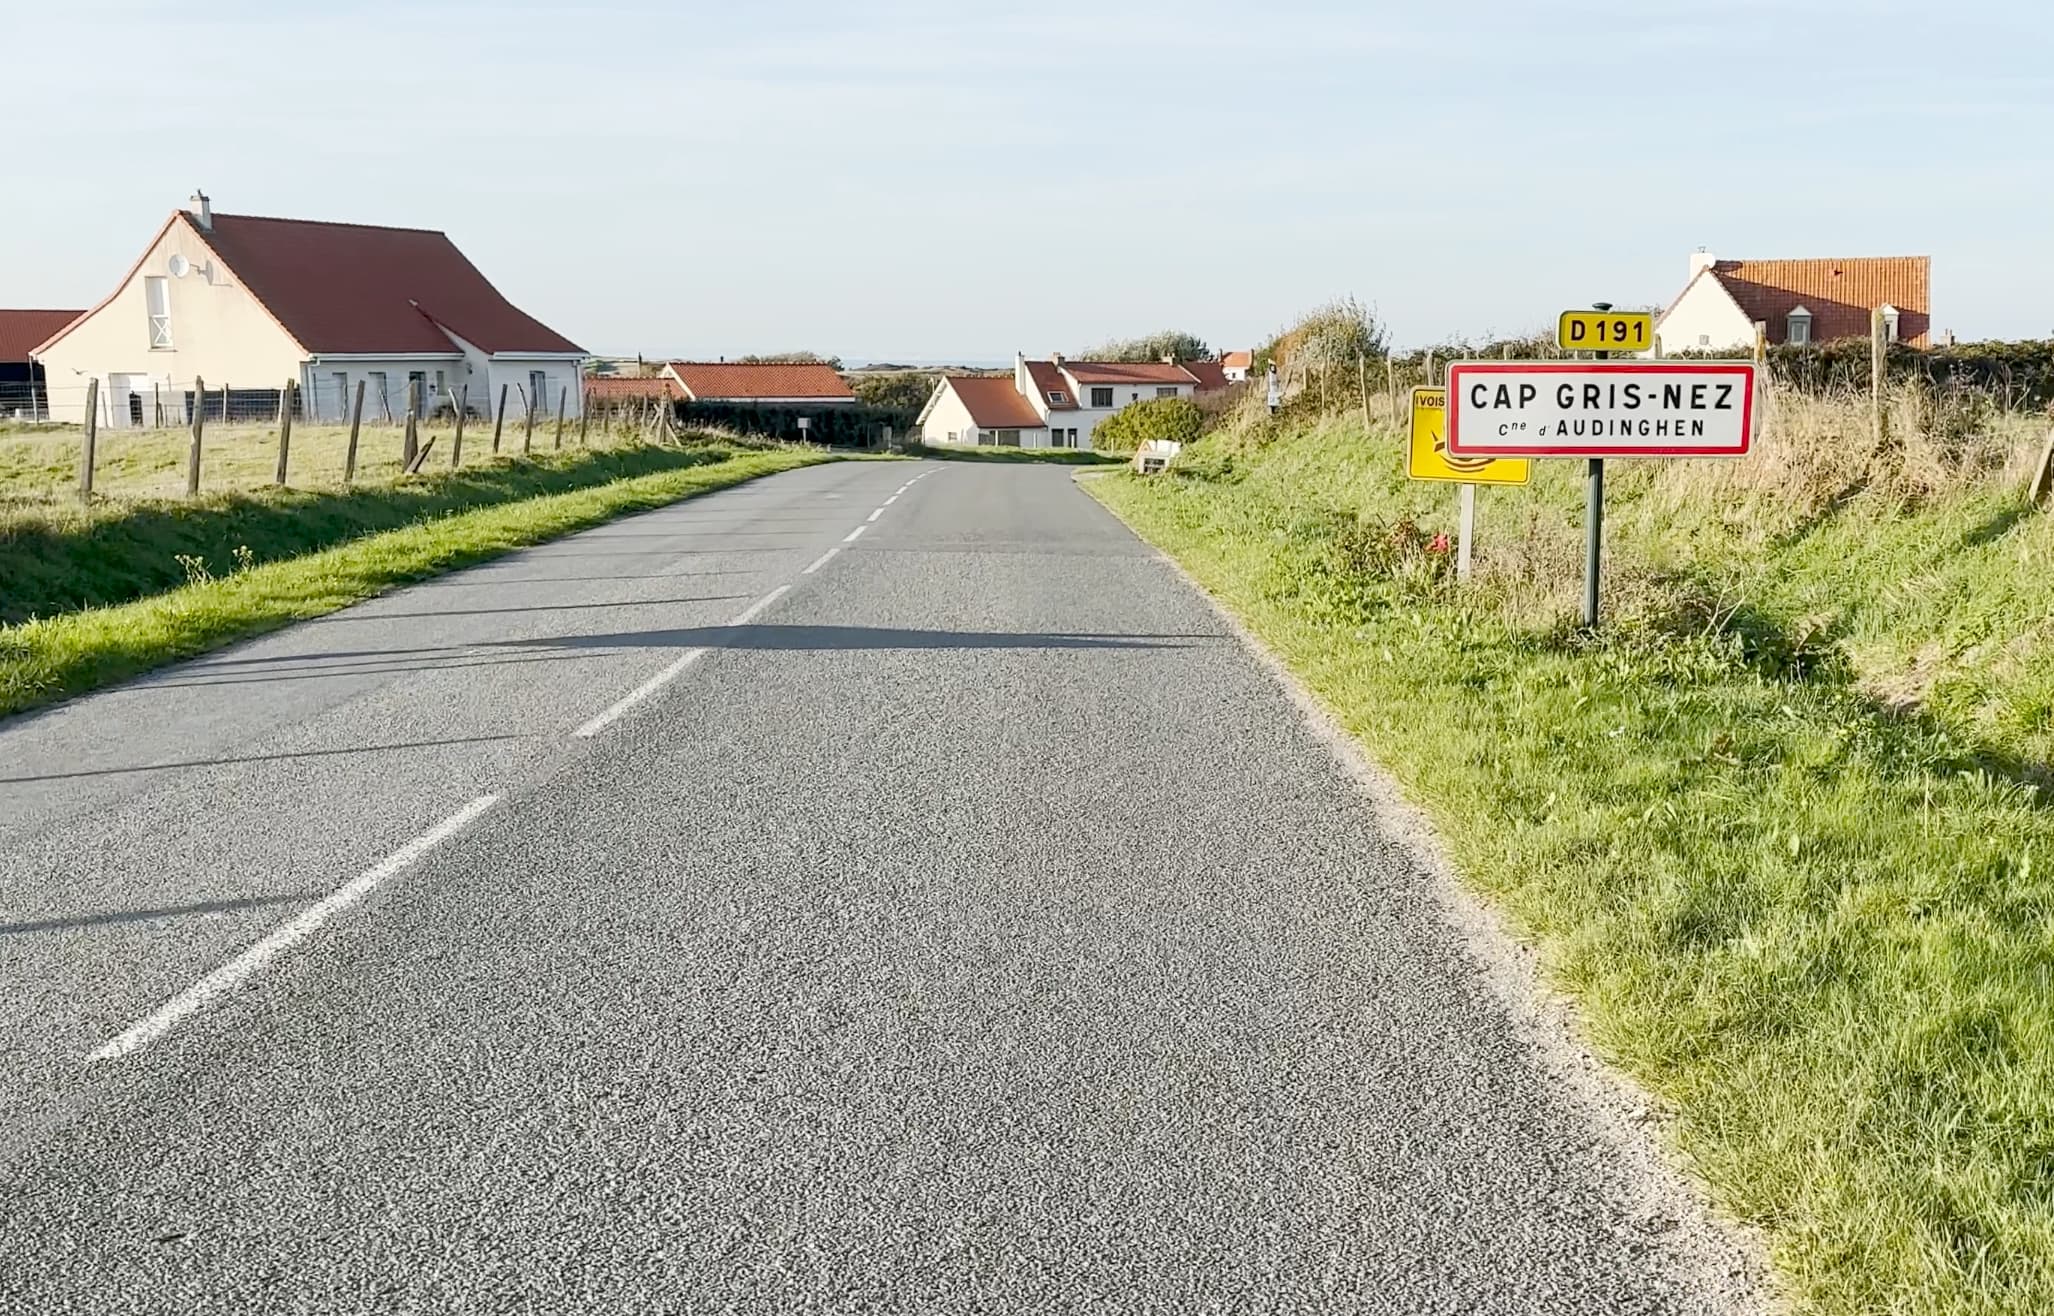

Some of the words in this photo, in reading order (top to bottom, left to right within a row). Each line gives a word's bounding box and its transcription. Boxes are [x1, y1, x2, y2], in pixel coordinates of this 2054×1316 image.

[1571, 320, 1586, 341] D
[1596, 320, 1643, 343] 191
[1470, 383, 1537, 409] CAP
[1556, 384, 1733, 410] GRIS-NEZ
[1498, 421, 1527, 436] Cne
